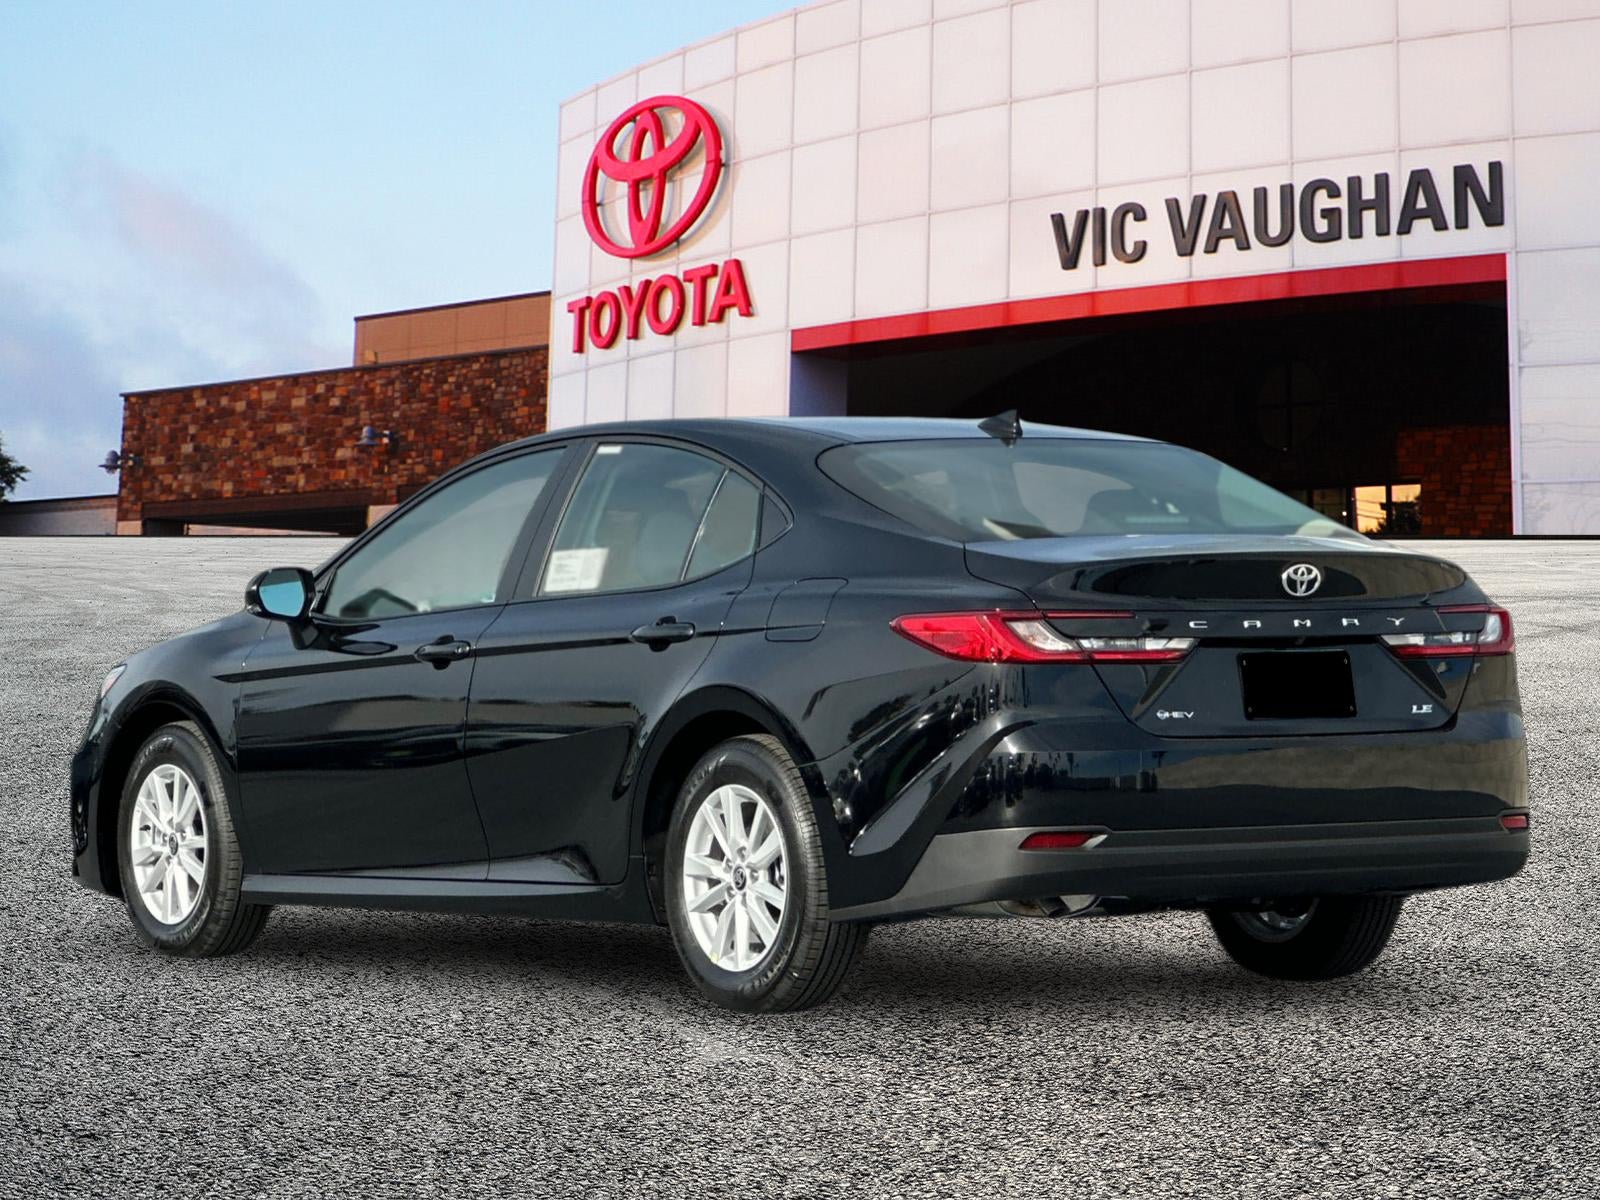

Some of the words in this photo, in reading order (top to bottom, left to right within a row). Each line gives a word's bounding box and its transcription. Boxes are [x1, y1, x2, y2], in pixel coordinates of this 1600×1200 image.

[1050, 202, 1147, 270] VIC
[1165, 161, 1504, 257] VAUGHAN
[567, 258, 754, 353] TOYOTA
[1189, 617, 1405, 628] CAMRY
[1411, 704, 1433, 714] LE
